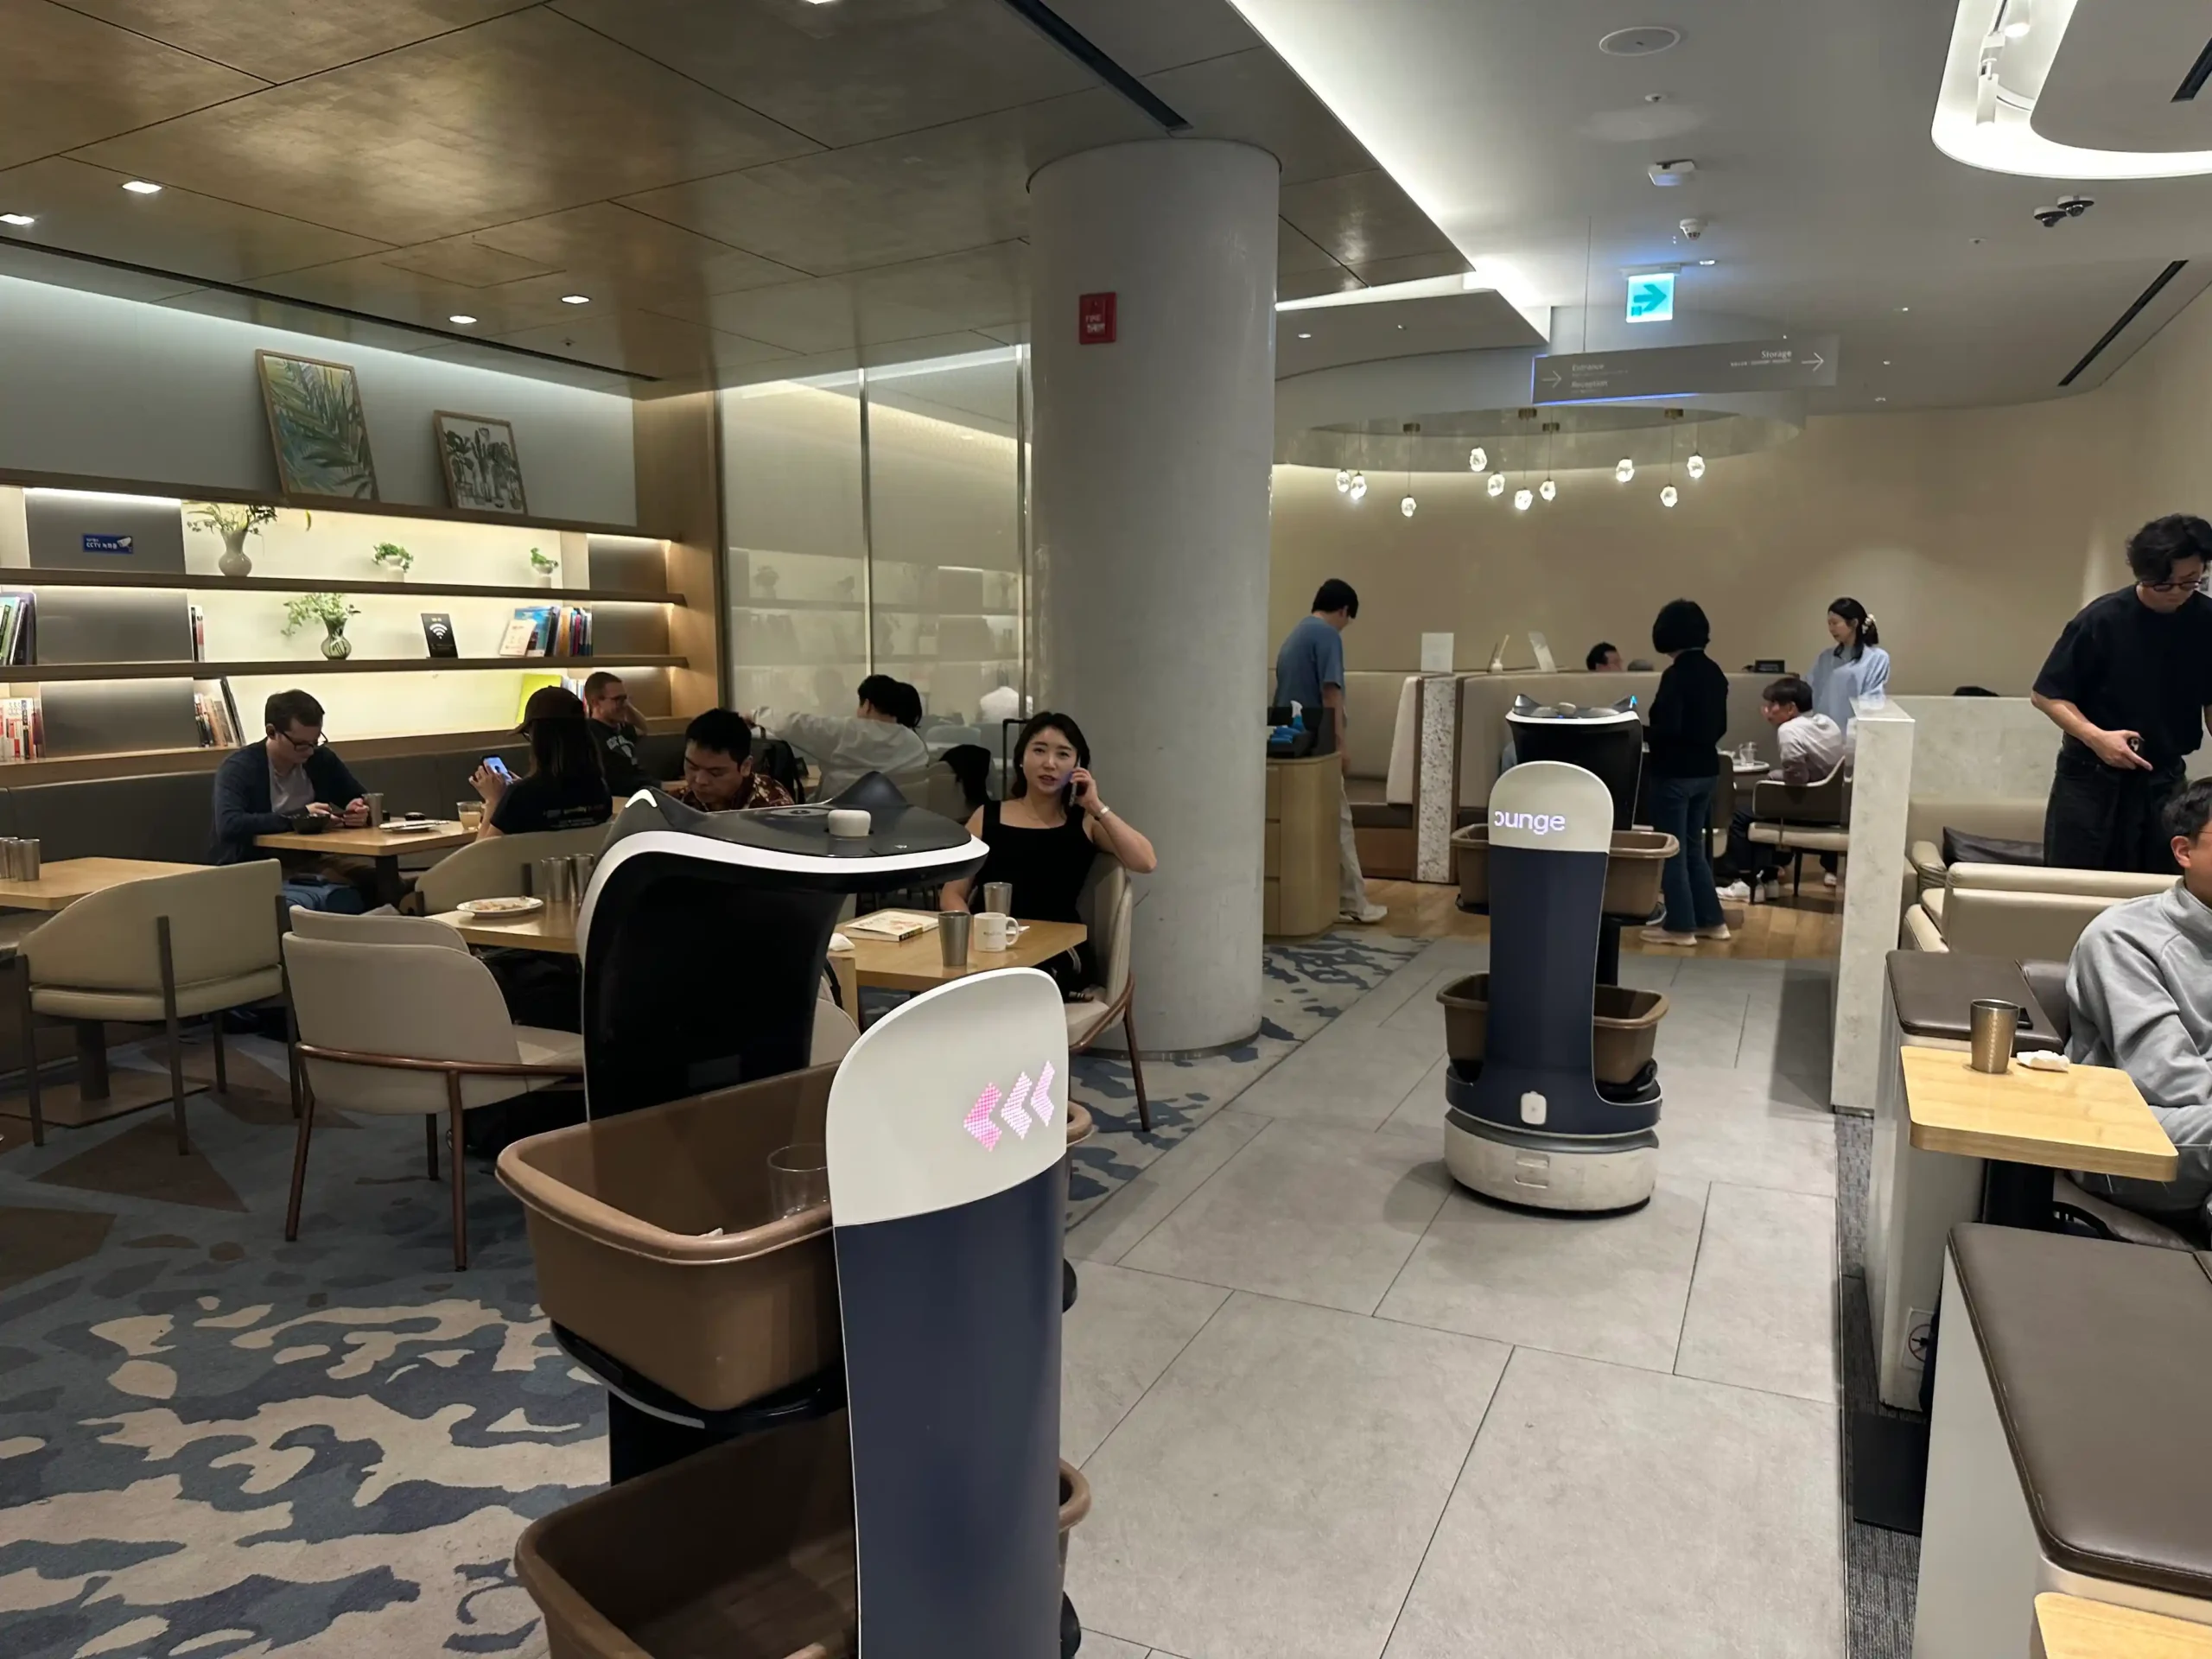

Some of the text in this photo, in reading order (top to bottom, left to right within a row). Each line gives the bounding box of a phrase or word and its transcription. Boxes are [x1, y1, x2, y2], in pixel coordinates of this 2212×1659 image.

[1761, 350, 1792, 359] Storage
[1572, 363, 1605, 372] Entrance
[1571, 379, 1608, 389] Reception
